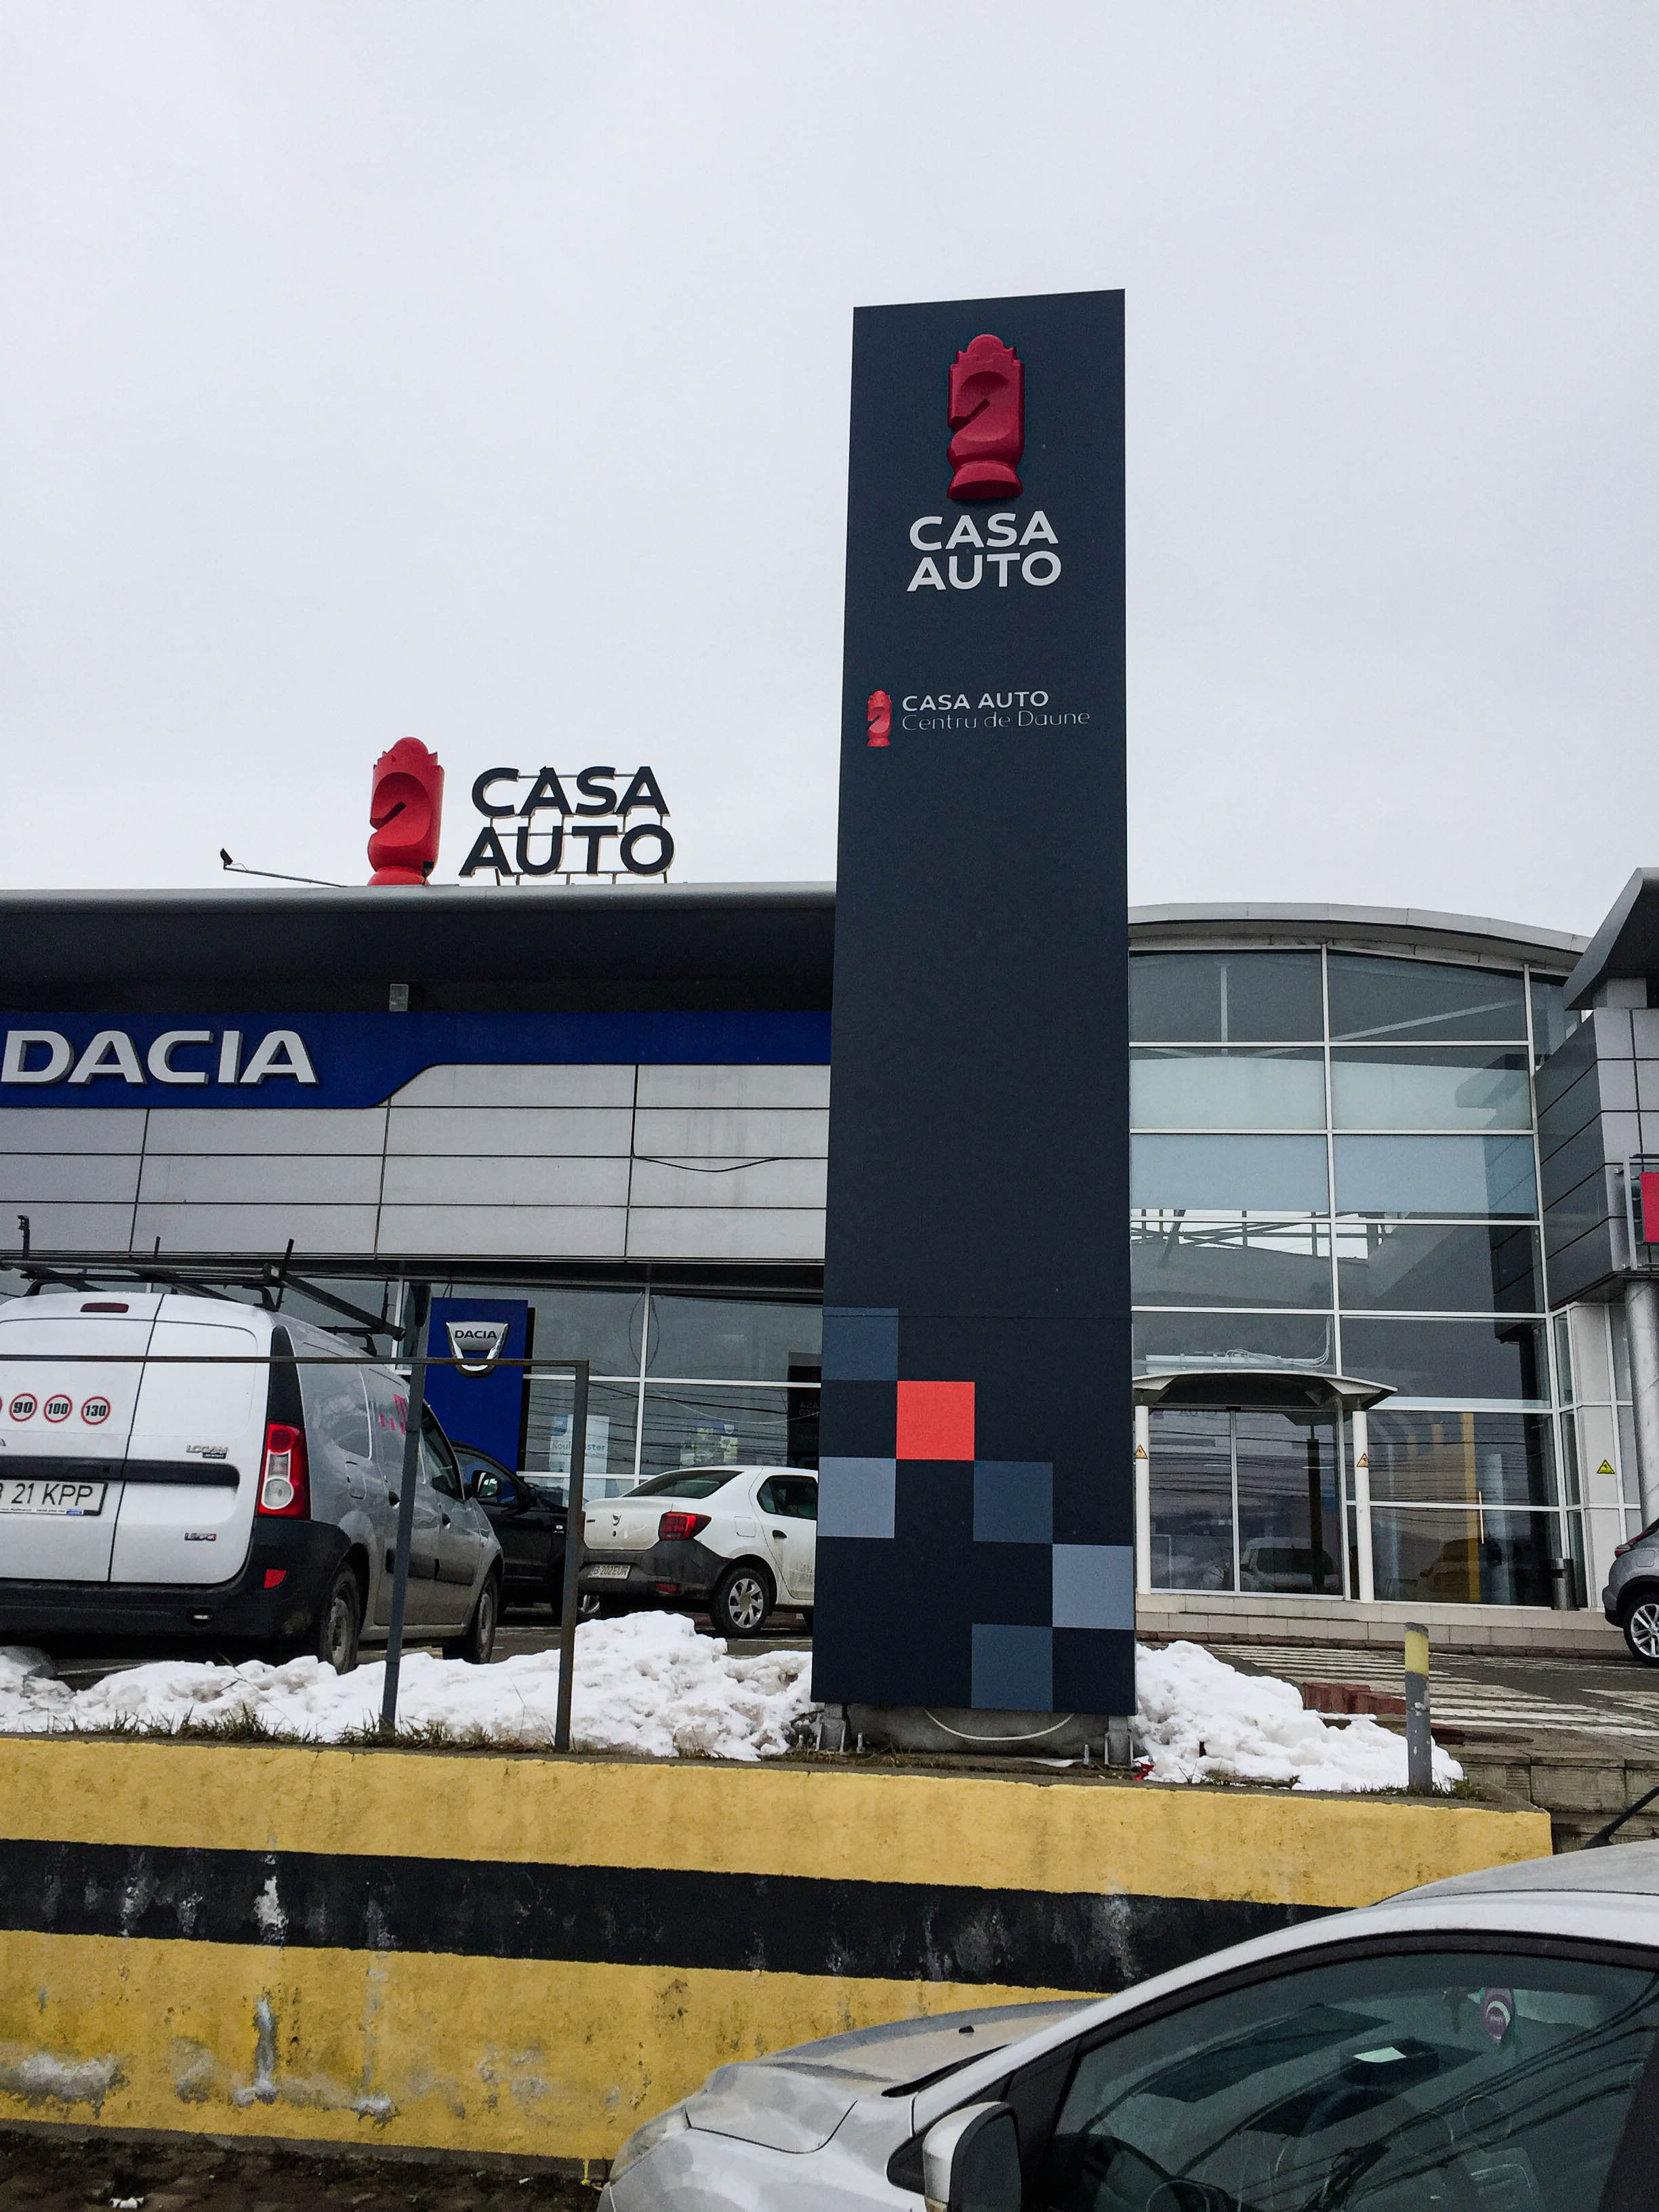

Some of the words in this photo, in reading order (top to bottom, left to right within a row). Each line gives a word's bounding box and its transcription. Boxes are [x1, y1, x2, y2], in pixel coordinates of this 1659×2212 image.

[909, 510, 1059, 551] CASA
[907, 550, 1061, 592] AUTO
[902, 694, 970, 712] CASA
[978, 690, 1049, 709] AUTO
[902, 714, 977, 731] Centru
[983, 712, 1010, 728] de
[1018, 710, 1090, 727] Daune
[472, 766, 670, 819] CASA
[458, 823, 674, 878] AUTO
[1, 1030, 319, 1084] DACIA
[455, 1330, 497, 1339] DACIA
[12, 1401, 33, 1414] 90
[47, 1403, 69, 1415] 100
[85, 1405, 107, 1417] 130
[11, 1483, 35, 1504] 21
[41, 1483, 93, 1506] KPP
